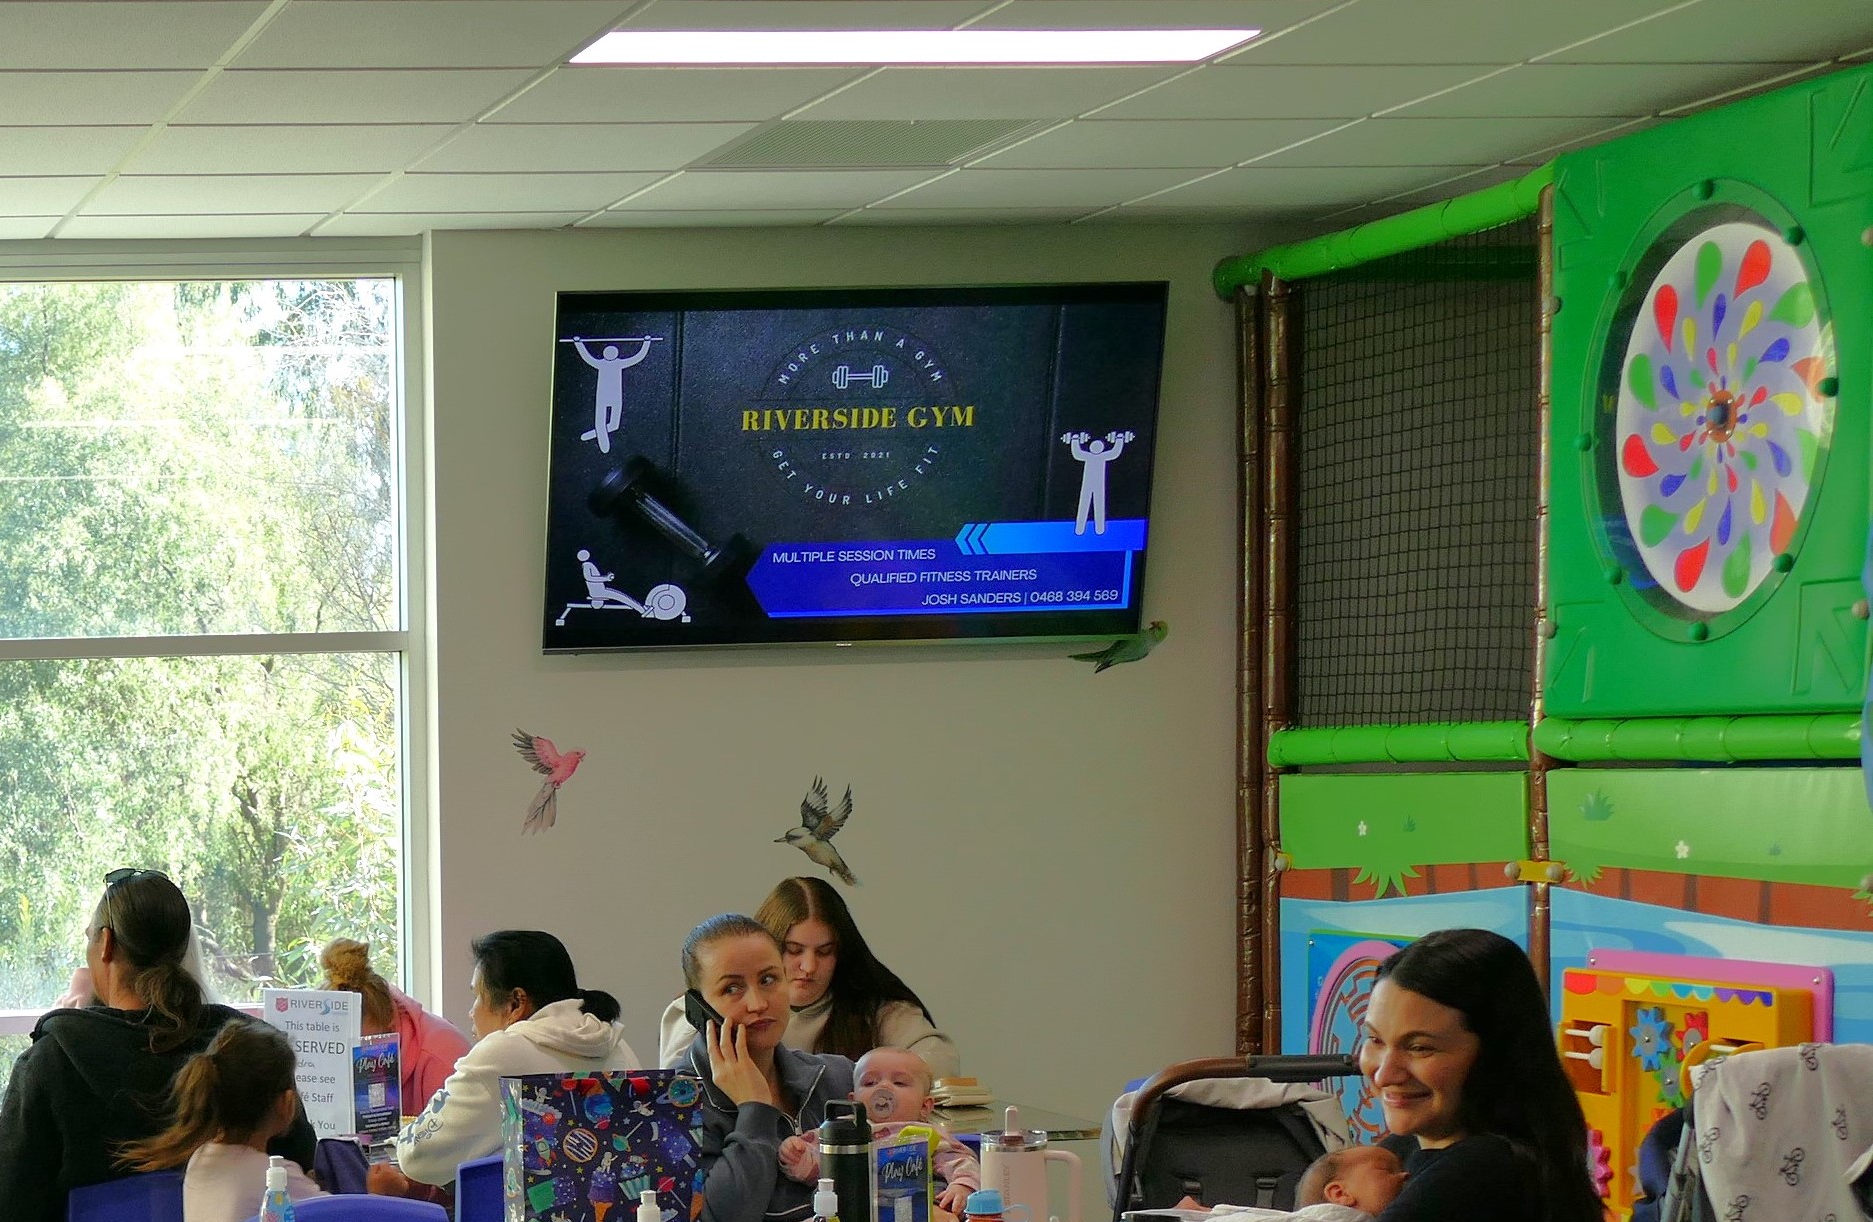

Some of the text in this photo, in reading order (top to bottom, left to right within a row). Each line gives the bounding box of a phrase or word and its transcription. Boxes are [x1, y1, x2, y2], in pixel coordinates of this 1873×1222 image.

[778, 330, 943, 385] MORE THAN A GYM
[741, 405, 975, 431] RIVERSIDE GYM
[822, 451, 890, 460] ESTD 2021
[772, 446, 939, 505] GET YOUR LIFE FIT
[772, 549, 936, 564] MULTIPLE SESSION TIMES
[850, 569, 1038, 586] QUALIFIED FITNESS TRAINERS
[921, 589, 1119, 606] JOSH SANDERS 0468 394 569
[290, 999, 349, 1014] RIVERSIDE
[285, 1021, 340, 1032] This table is
[295, 1040, 345, 1055] SERVED
[296, 1074, 336, 1084] ease see
[312, 1092, 334, 1103] Staff
[318, 1121, 336, 1130] You
[882, 1162, 904, 1182] Play
